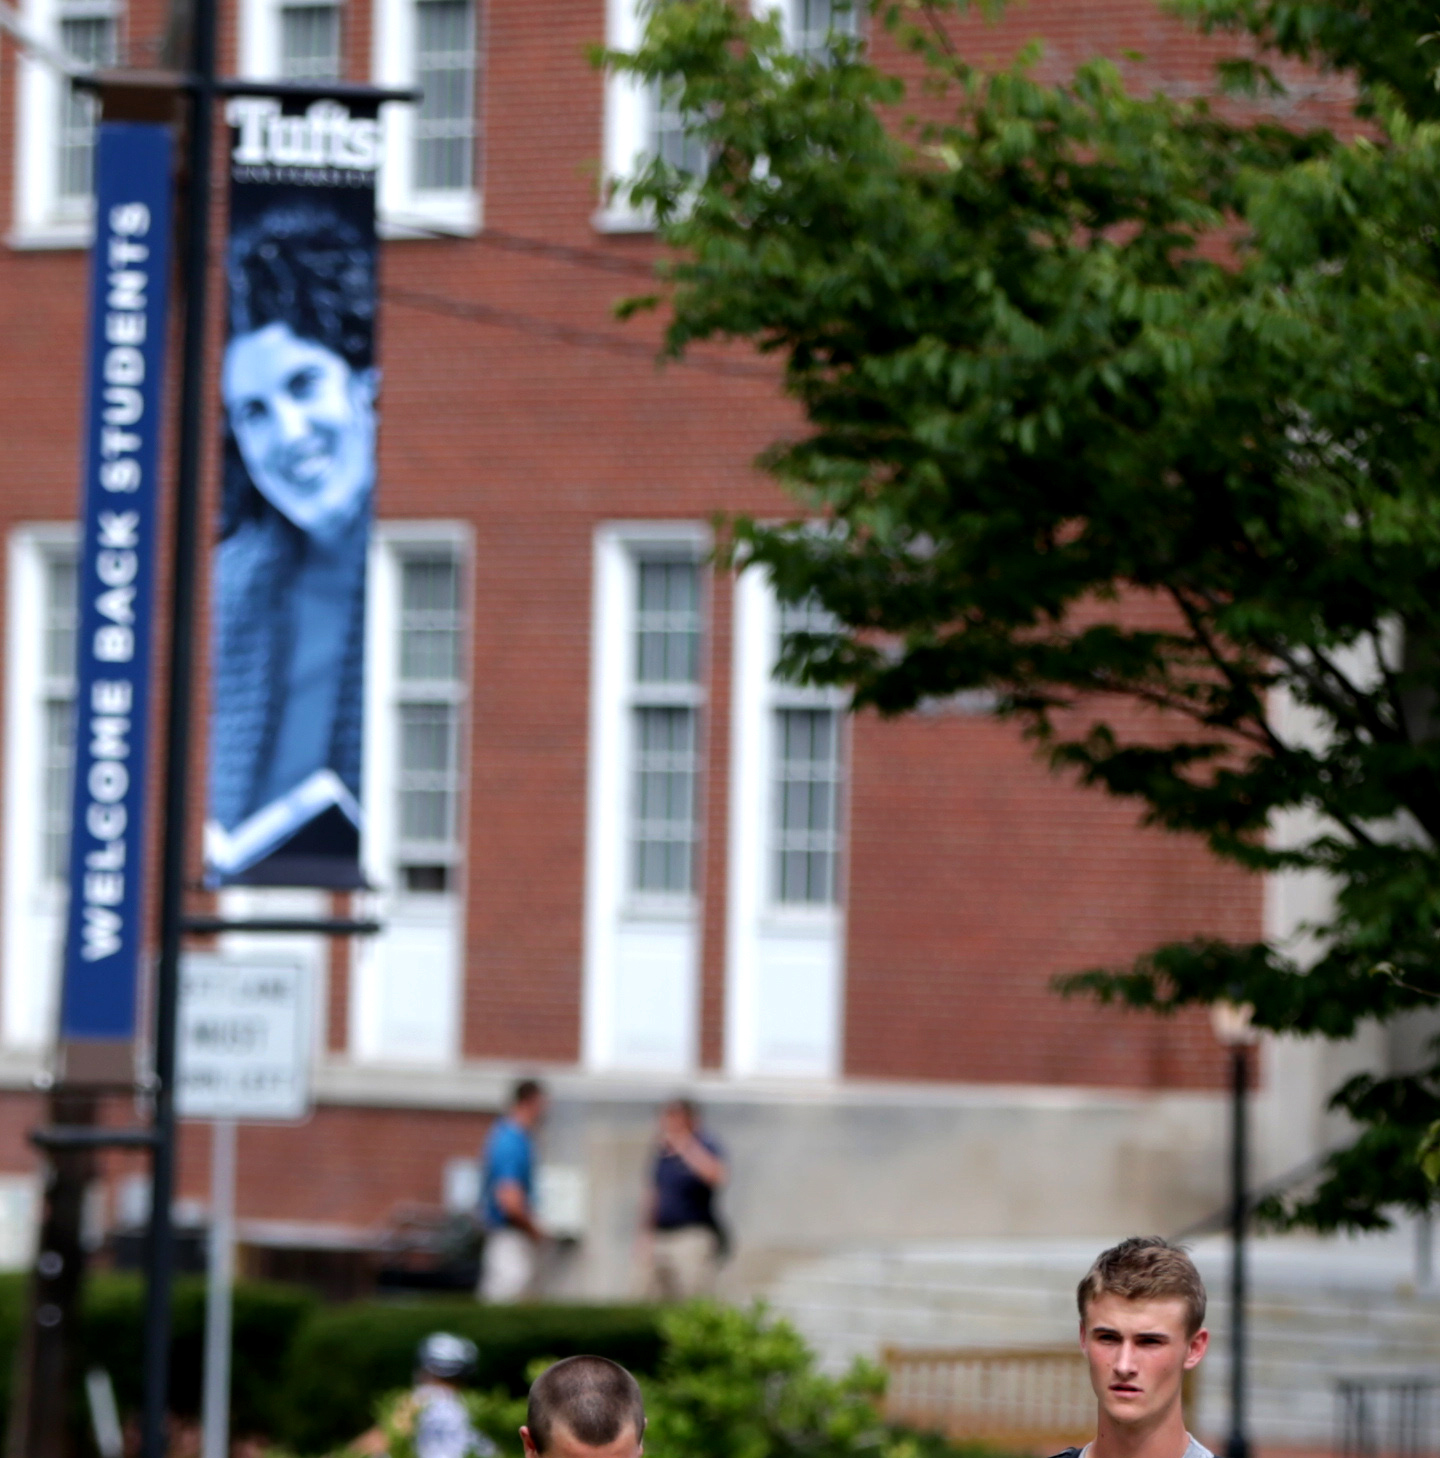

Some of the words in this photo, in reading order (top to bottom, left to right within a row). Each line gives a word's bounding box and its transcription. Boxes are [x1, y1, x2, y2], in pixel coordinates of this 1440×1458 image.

[225, 95, 379, 171] Tufts
[99, 201, 151, 494] STUDENTS
[92, 509, 140, 663] BACK
[80, 678, 133, 963] WELCOME
